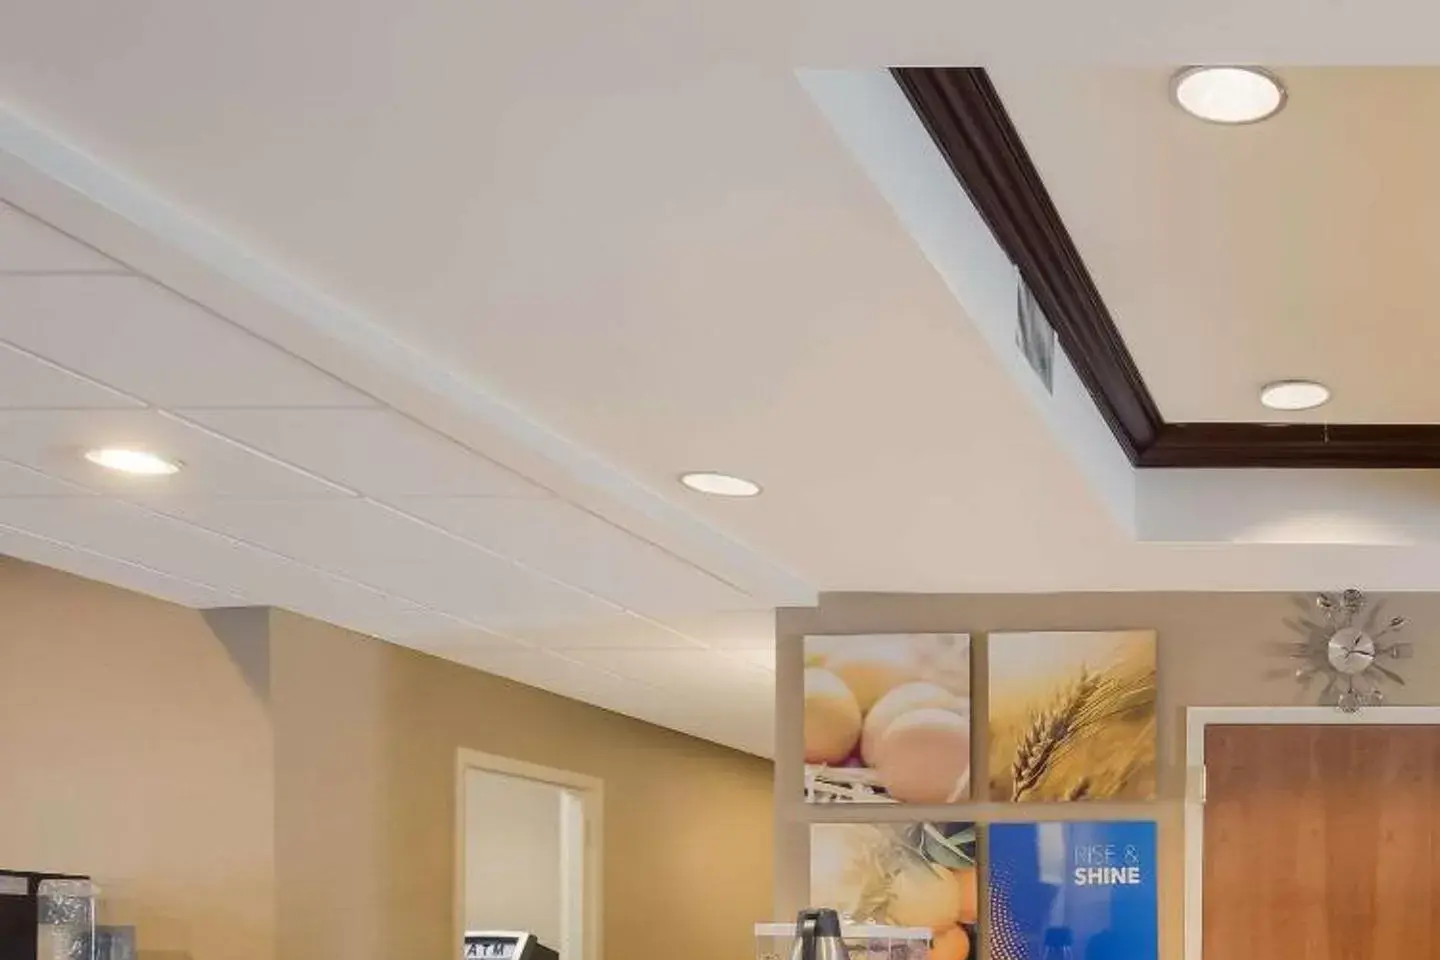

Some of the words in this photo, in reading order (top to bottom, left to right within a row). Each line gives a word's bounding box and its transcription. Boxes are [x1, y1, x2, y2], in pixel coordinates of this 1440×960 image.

[1075, 844, 1116, 866] RISE
[1125, 844, 1139, 866] &
[1074, 867, 1140, 885] SHINE
[467, 943, 504, 956] ATM
